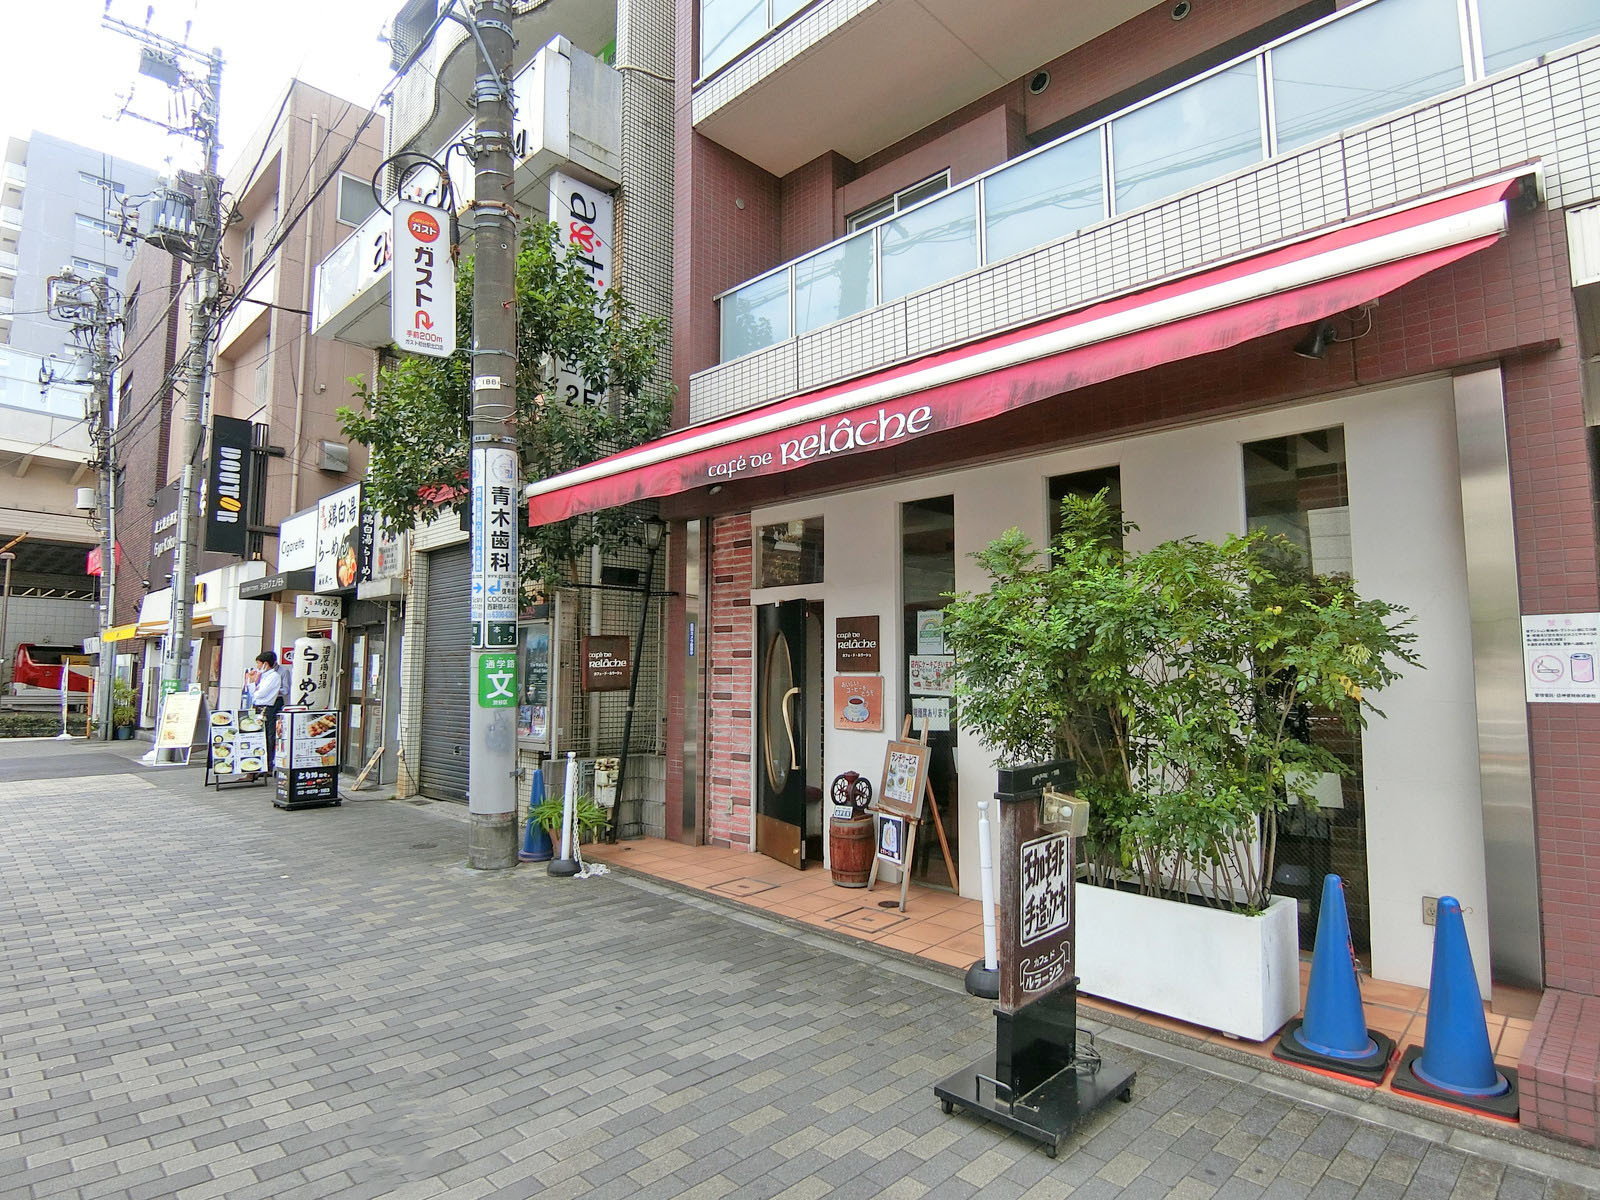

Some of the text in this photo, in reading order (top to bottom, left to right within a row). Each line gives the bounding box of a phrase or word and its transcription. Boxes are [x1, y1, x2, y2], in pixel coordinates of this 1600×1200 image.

[412, 222, 437, 236] ガスト
[414, 246, 434, 308] ガスト
[708, 456, 747, 479] café
[780, 405, 933, 466] Relâche
[217, 446, 242, 523] DOUTOR
[491, 486, 510, 572] 青木歯科
[281, 538, 305, 558] Cigarette
[318, 532, 349, 563] らーめん
[303, 606, 339, 617] らーめん
[314, 598, 339, 607] 鶏白湯
[497, 636, 512, 646] 1-2
[837, 639, 877, 650] Relâche
[486, 658, 515, 669] 通学路
[588, 658, 628, 669] Relâche
[297, 645, 320, 710] らーめん
[486, 670, 514, 699] 文
[1024, 839, 1065, 892] 珈琲
[1025, 963, 1063, 990] ルラーシュ
